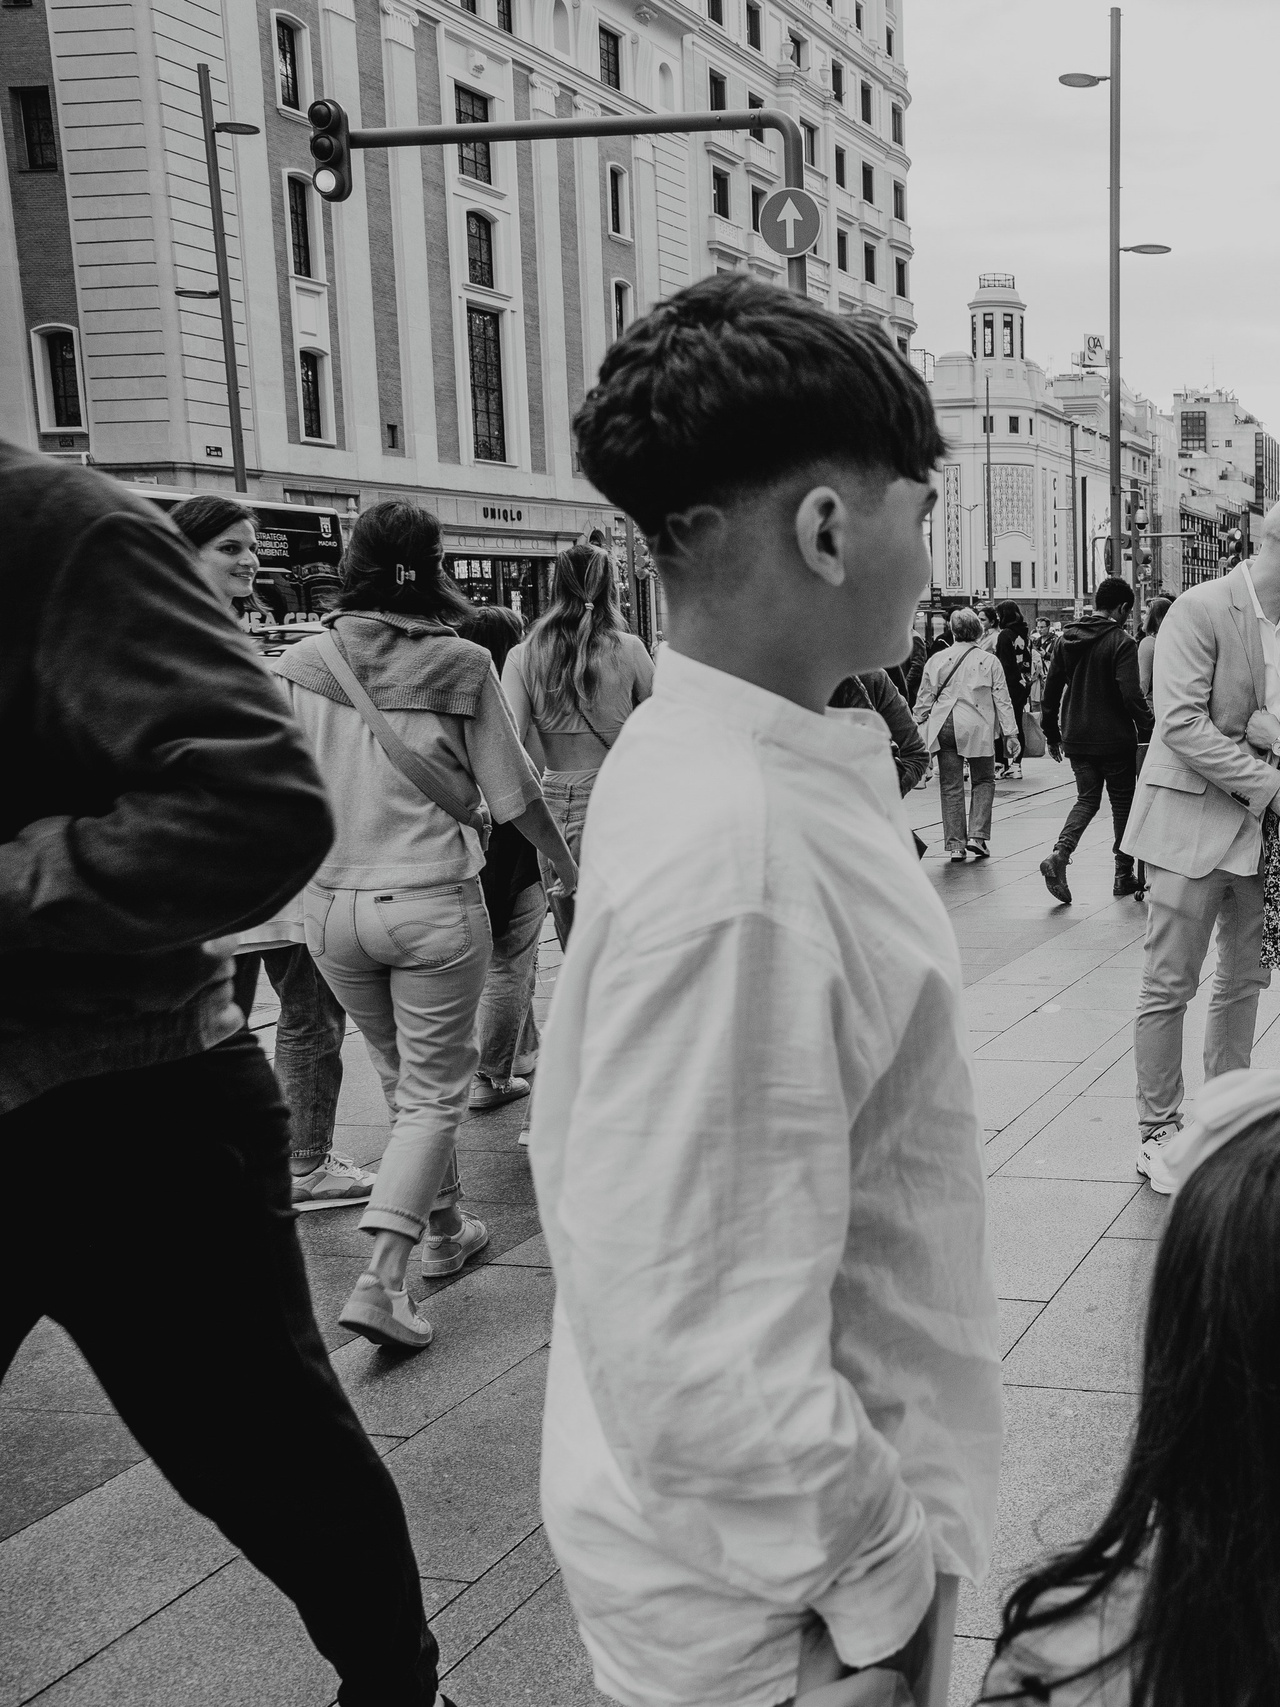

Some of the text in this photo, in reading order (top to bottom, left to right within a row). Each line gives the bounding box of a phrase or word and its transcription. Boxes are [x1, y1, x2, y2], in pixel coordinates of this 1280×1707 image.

[482, 506, 523, 523] UNIQLO
[256, 532, 288, 541] STRATEGIA
[257, 540, 289, 550] ENIBILIDAD
[257, 548, 290, 557] AMBIENTAL
